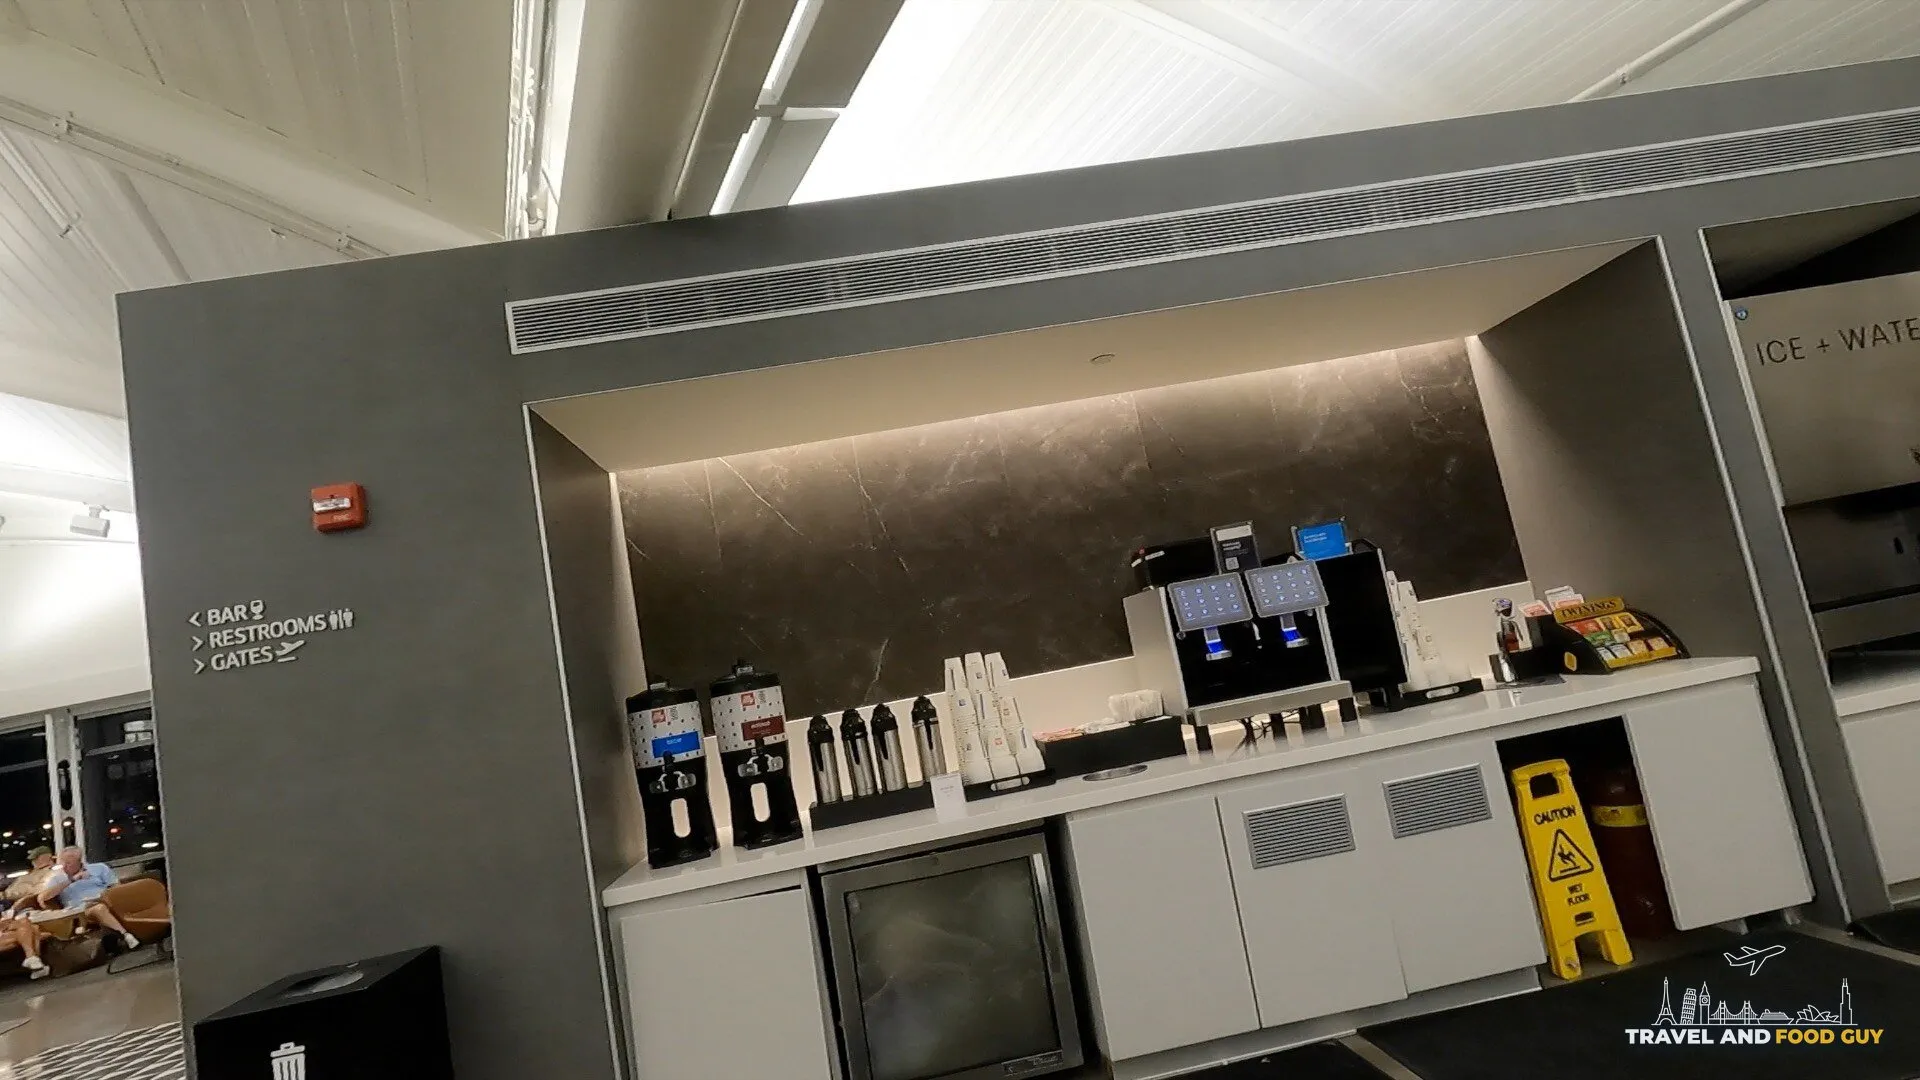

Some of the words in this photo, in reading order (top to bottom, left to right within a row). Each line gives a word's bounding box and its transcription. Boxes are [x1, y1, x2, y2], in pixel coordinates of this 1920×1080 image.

[1756, 336, 1806, 366] ICE
[1838, 317, 1920, 352] WATE
[207, 604, 248, 626] BAR
[1560, 600, 1617, 618] TWININGS
[209, 614, 328, 649] RESTROOMS
[210, 645, 274, 671] GATES
[1533, 804, 1577, 826] CAUTION
[1567, 883, 1583, 895] WET
[1567, 893, 1590, 906] FLOOR
